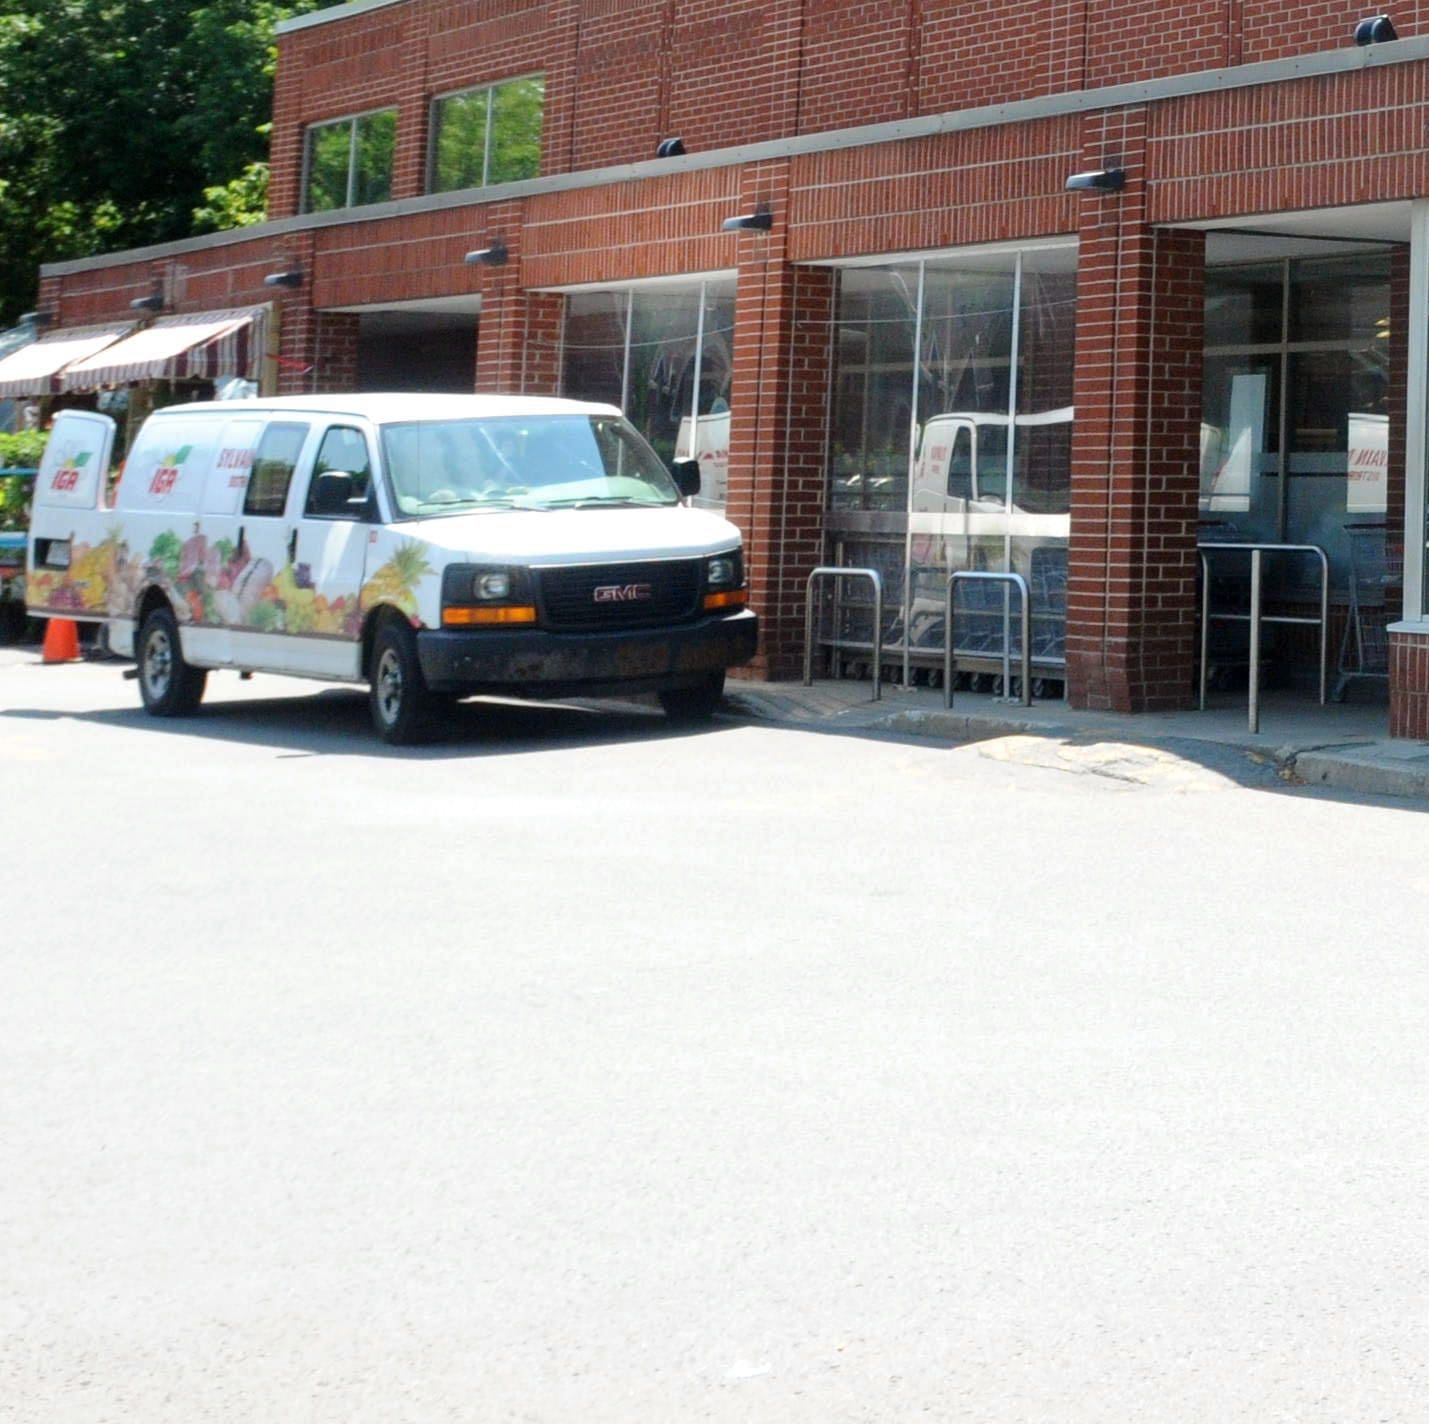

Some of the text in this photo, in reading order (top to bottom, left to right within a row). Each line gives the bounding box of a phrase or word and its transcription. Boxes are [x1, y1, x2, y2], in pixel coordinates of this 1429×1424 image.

[50, 469, 80, 492] IGA
[148, 468, 178, 494] IGA
[593, 584, 651, 602] GMC
